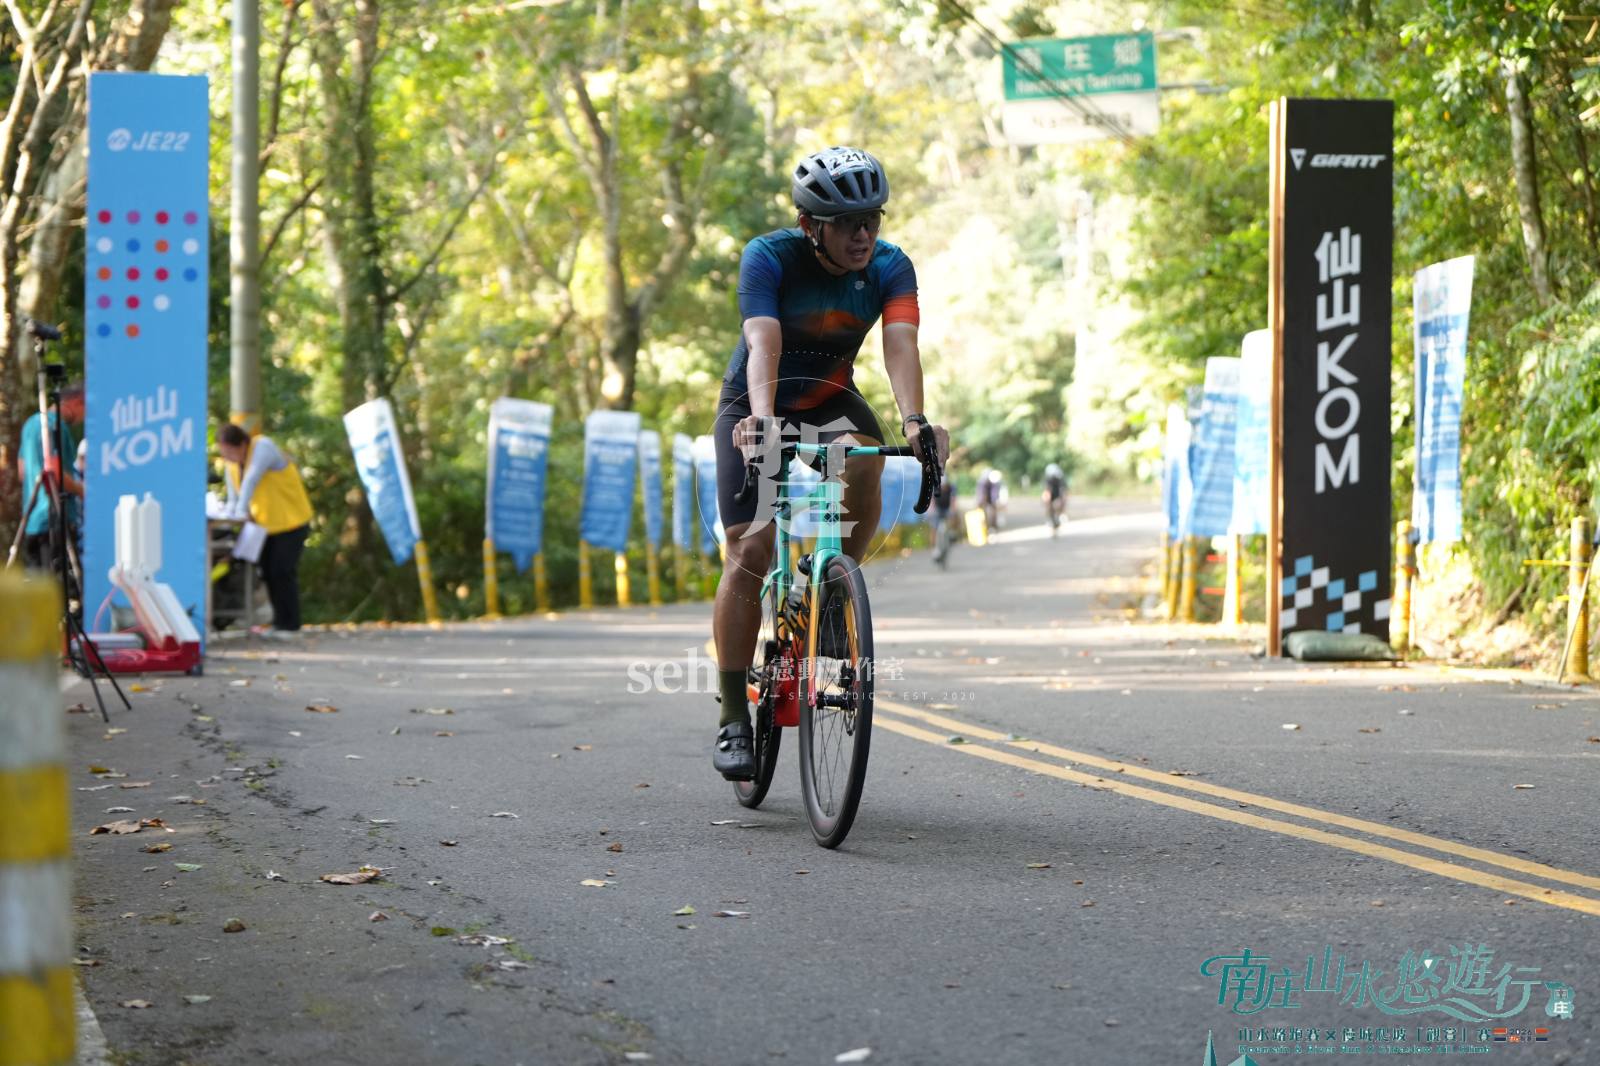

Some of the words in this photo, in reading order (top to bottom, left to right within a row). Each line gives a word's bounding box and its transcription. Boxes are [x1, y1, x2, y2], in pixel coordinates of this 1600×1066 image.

[131, 131, 191, 151] JE22
[1310, 153, 1386, 168] GIANT
[110, 385, 178, 435] 仙山
[101, 417, 192, 475] KOM
